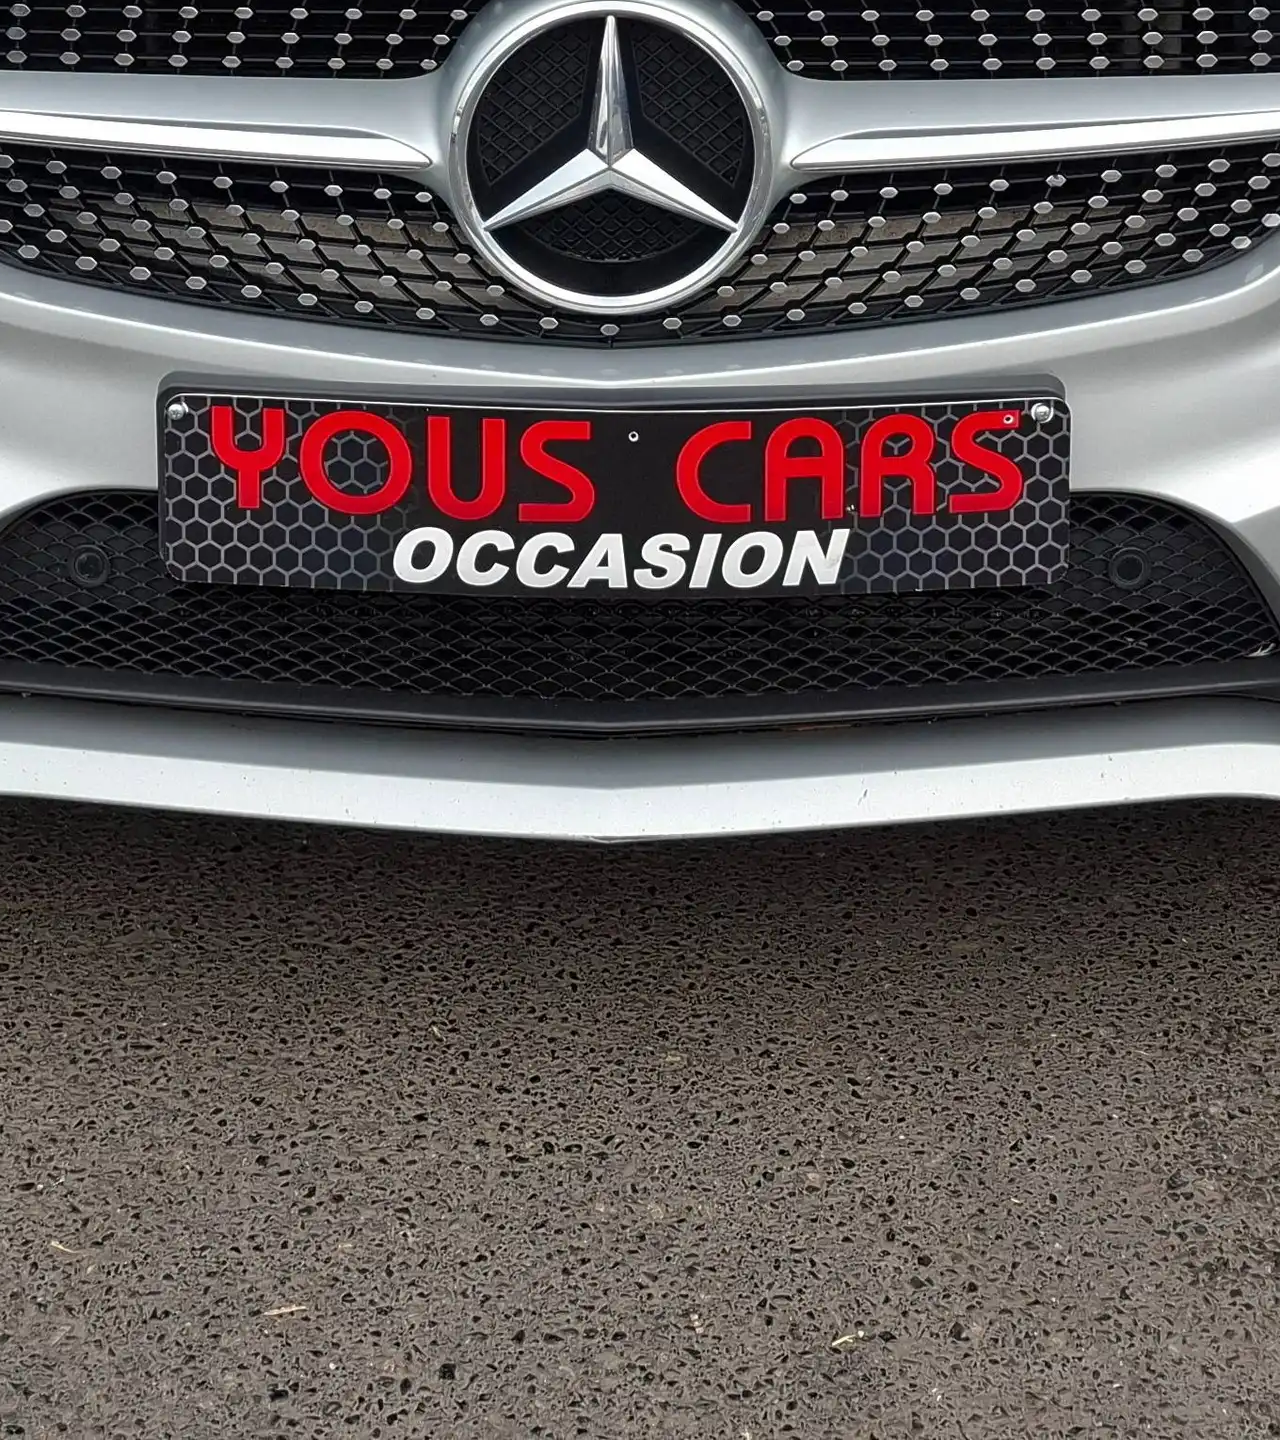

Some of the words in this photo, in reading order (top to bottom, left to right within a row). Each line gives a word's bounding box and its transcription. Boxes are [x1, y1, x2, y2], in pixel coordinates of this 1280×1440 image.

[209, 404, 596, 522] YOUS
[676, 410, 1026, 525] CARS
[392, 526, 850, 590] OCCASION
